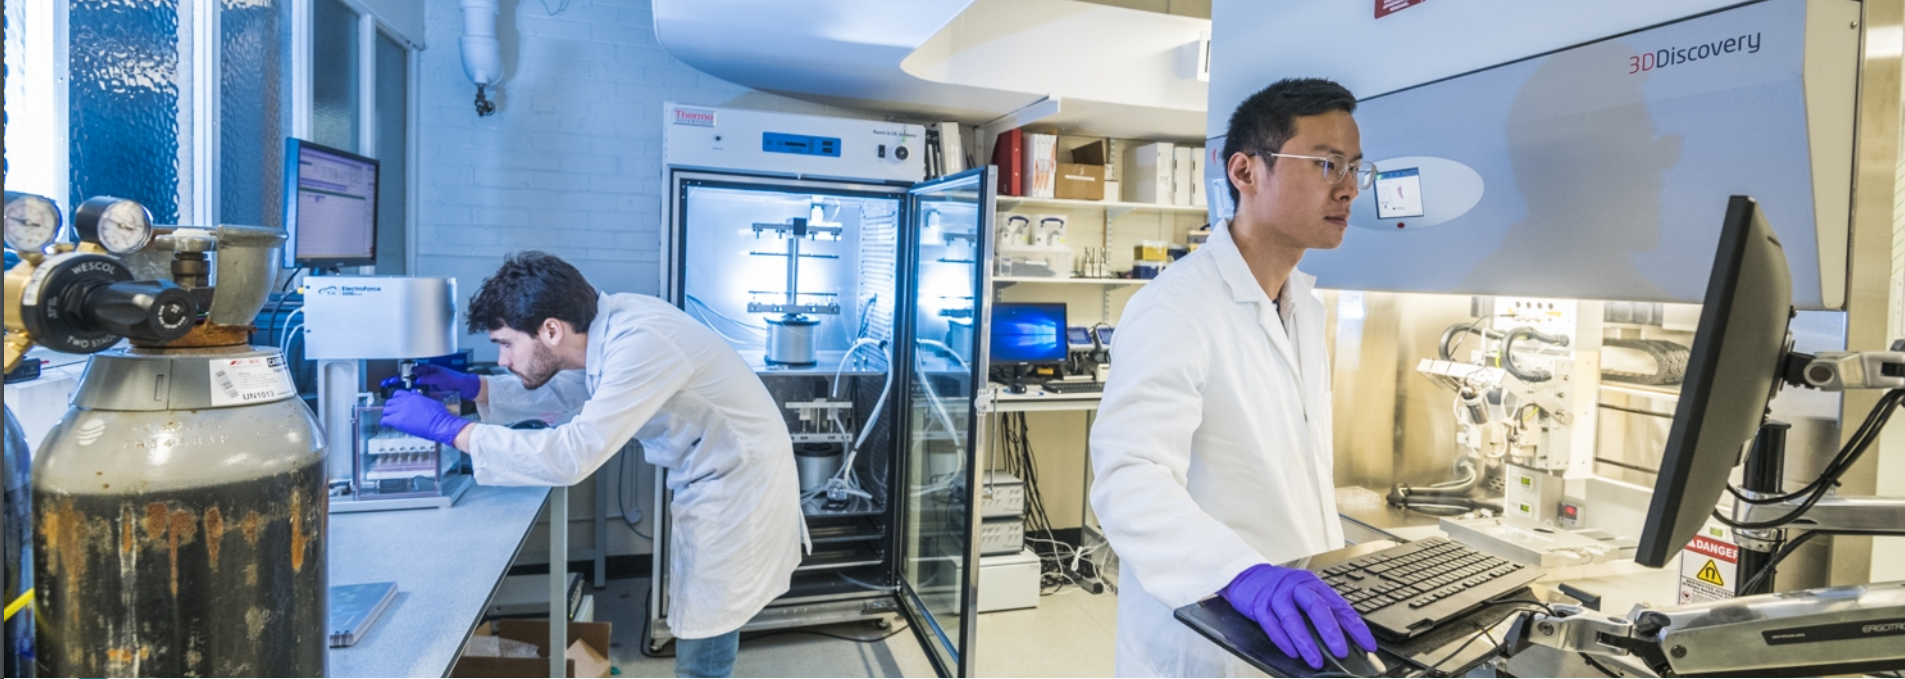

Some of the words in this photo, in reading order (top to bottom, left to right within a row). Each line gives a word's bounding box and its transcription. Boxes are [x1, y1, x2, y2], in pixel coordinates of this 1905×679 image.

[1629, 32, 1761, 74] 3DDiscovery
[675, 109, 714, 121] Thermo
[72, 262, 115, 275] WESCOL
[67, 335, 90, 348] TWO
[242, 390, 275, 401] UN1013
